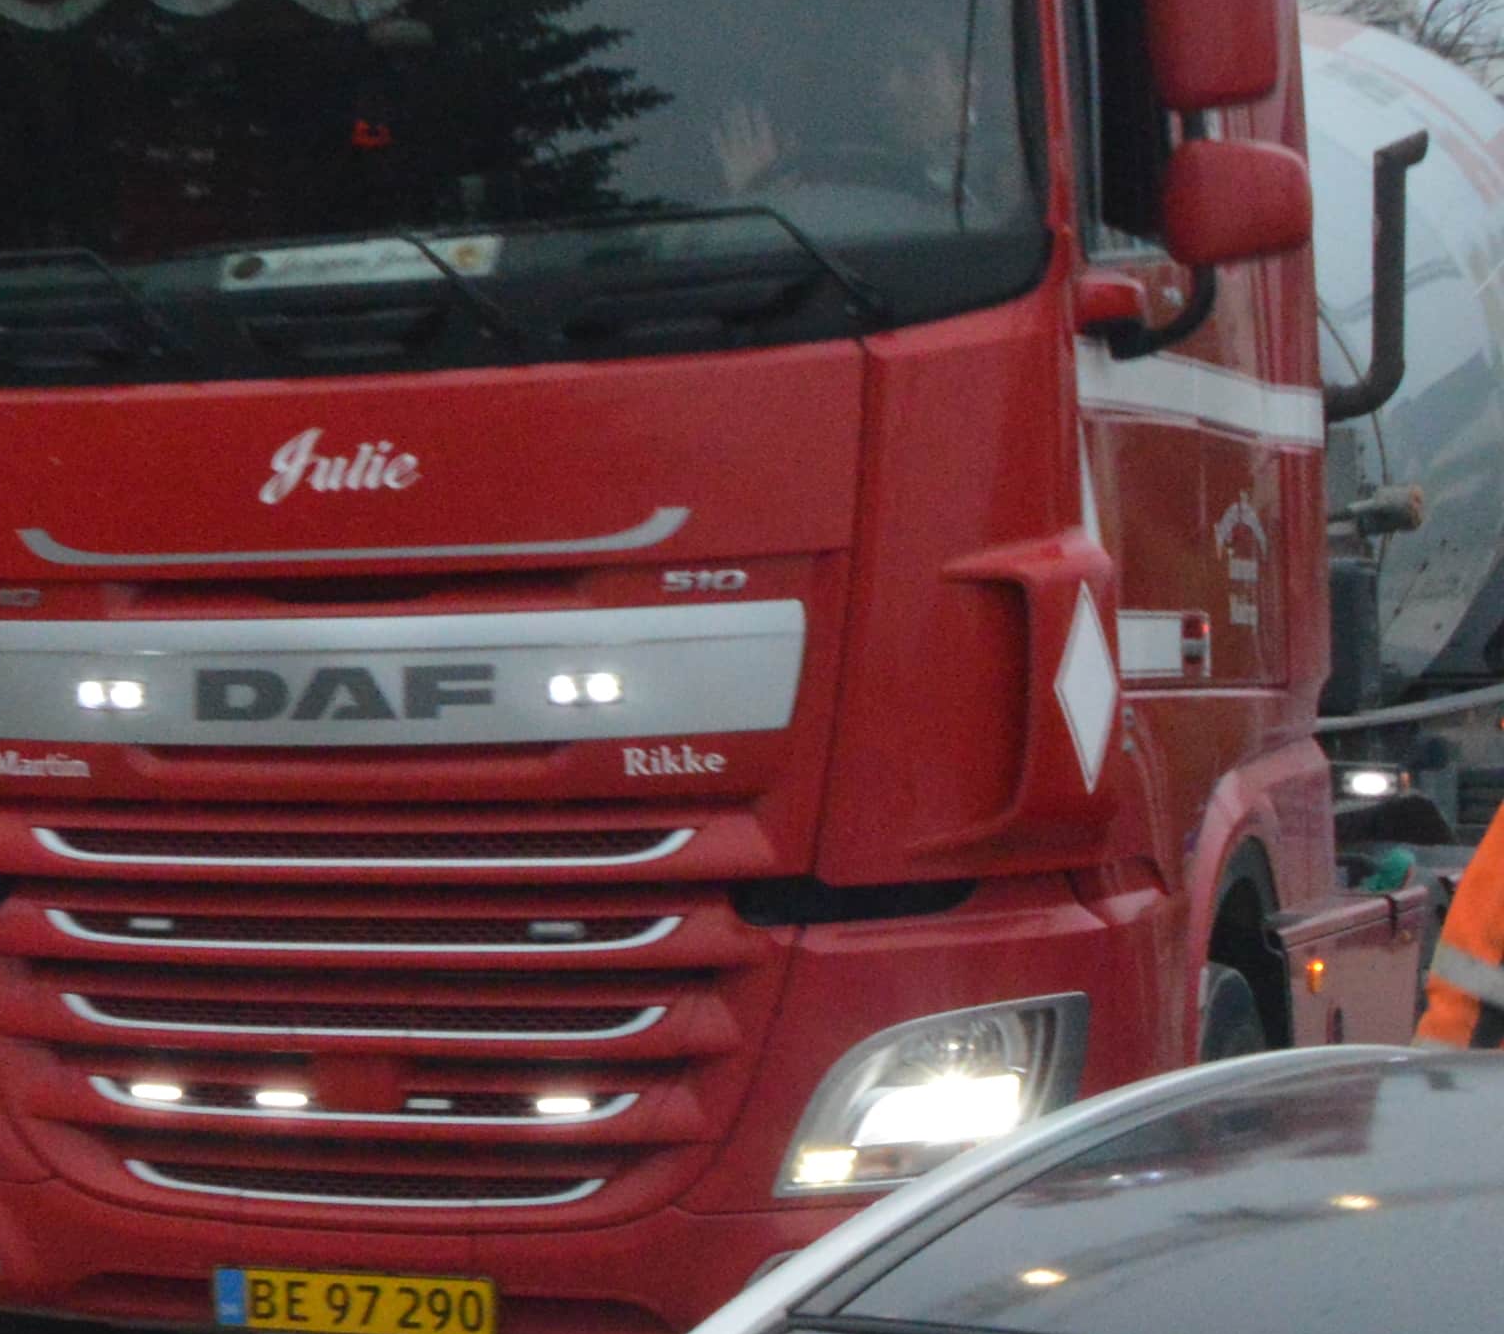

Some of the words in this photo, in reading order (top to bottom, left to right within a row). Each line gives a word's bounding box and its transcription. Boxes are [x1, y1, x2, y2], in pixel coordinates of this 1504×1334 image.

[257, 427, 424, 505] Julie
[662, 568, 749, 593] 510
[195, 664, 496, 722] DAF
[623, 744, 728, 777] Rikke
[249, 1278, 310, 1323] BE
[324, 1282, 382, 1327] 97
[396, 1286, 486, 1333] 290
